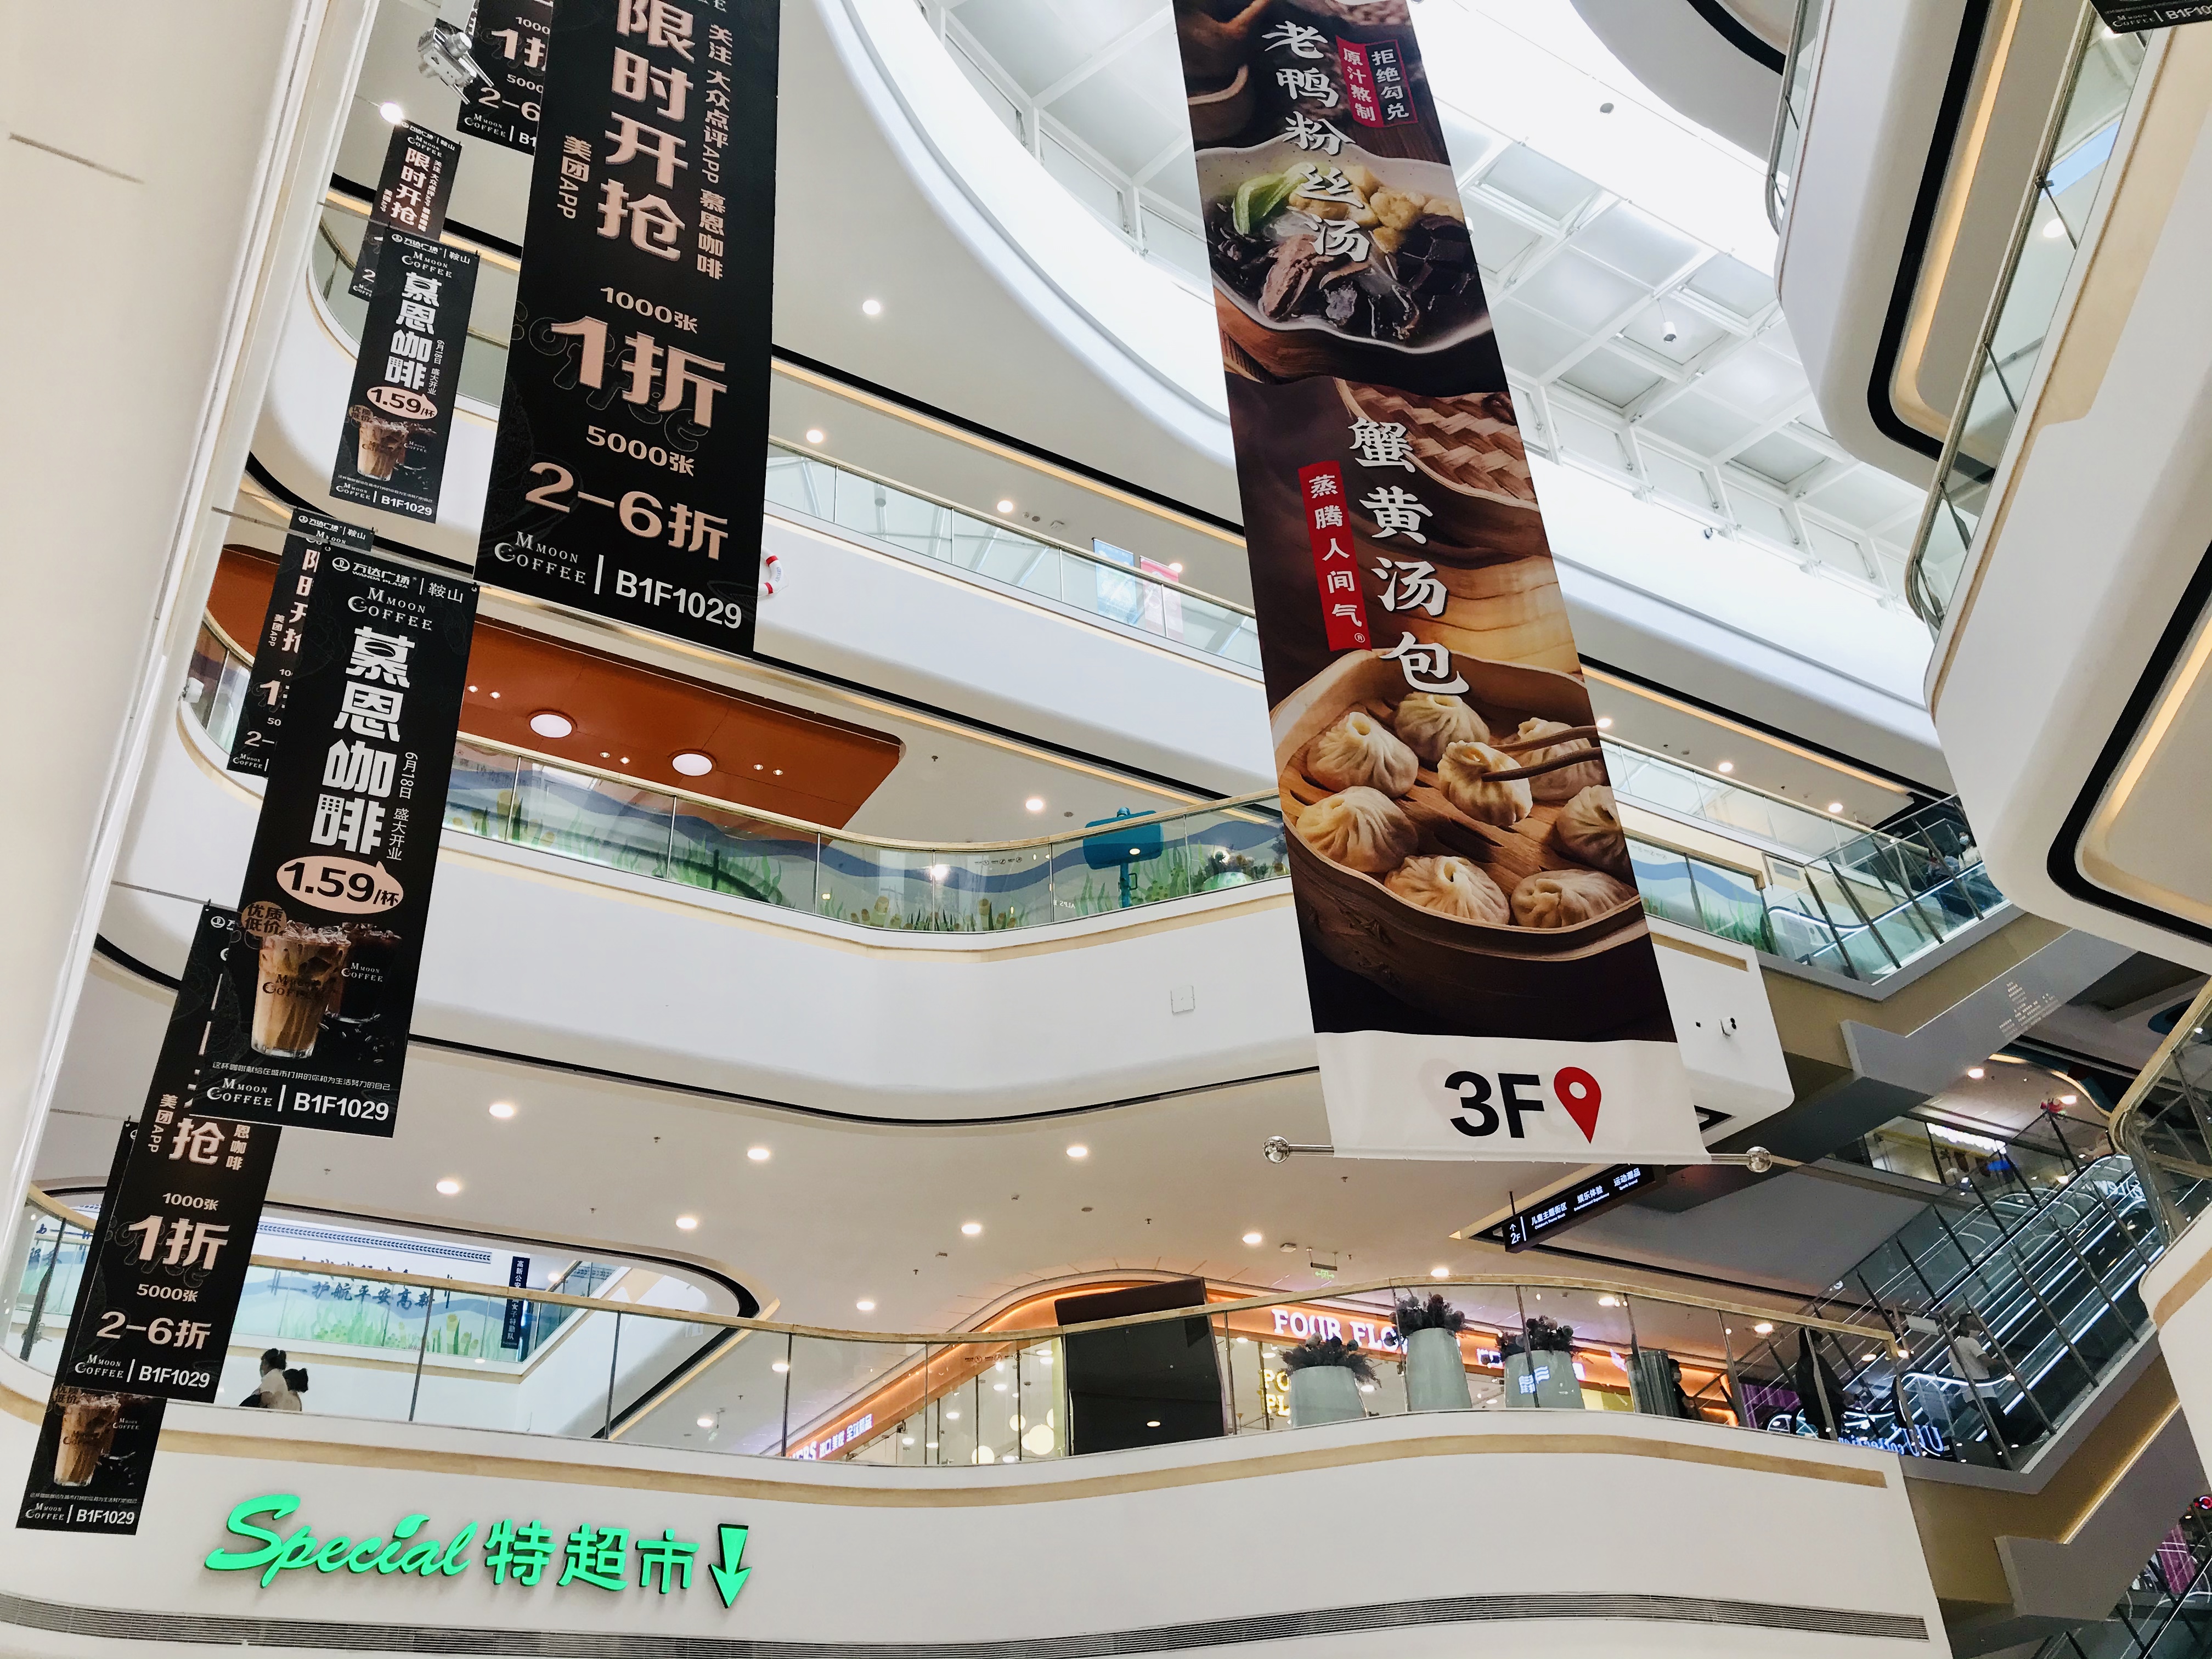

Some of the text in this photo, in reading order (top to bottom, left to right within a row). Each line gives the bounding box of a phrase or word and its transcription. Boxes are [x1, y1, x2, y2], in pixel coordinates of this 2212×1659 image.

[708, 25, 732, 66] 关注
[1343, 47, 1376, 121] 原汁熬制
[1372, 48, 1410, 121] 拒绝勾兑
[464, 117, 506, 138] COFFEE
[597, 0, 695, 262] 限时开抢
[702, 69, 731, 184] 大众点评APP
[1262, 20, 1371, 262] 老鸭粉丝汤
[390, 147, 431, 226] 限时开抢
[557, 135, 591, 219] 美团APP
[697, 188, 725, 280] 慕恩咖啡
[402, 255, 452, 278] COFFEE
[449, 251, 470, 264] 鞍山
[600, 287, 698, 334] 1000张
[385, 272, 442, 390] 慕恩咖啡
[551, 315, 727, 428] 1折
[371, 388, 435, 417] 1.59/杯
[586, 425, 695, 476] 5000张
[336, 485, 371, 500] COFFEE
[381, 495, 432, 516] B1F1029
[347, 528, 366, 540] 鞍山
[515, 531, 578, 564] MMOON
[1309, 474, 1363, 627] 蒸腾人间气
[494, 542, 586, 585] COFFEE
[1348, 416, 1469, 695] 蟹黄汤包
[353, 562, 463, 603] 万达广场 鞍山
[367, 587, 425, 613] MMOON
[616, 569, 742, 629] B1F1029
[268, 614, 284, 647] 美团APP
[348, 596, 433, 631] COFFEE
[310, 626, 415, 855] 慕恩咖啡
[233, 757, 262, 769] COFFEE
[386, 752, 418, 861] 6月18日 盛大开业
[284, 862, 399, 906] 1.59/杯
[247, 905, 283, 922] 优质
[341, 968, 383, 982] COFFEE
[207, 1086, 273, 1107] COFFEE
[222, 1078, 268, 1093] MMOON
[1444, 1070, 1546, 1138] 3F
[148, 1094, 178, 1153] 美团APP
[294, 1092, 389, 1120] B1F1029
[226, 1124, 251, 1171] 恩咖啡
[1577, 1185, 1603, 1204] 娱乐体验
[1613, 1167, 1641, 1187] 运动潮品
[162, 1193, 219, 1211] 1000张
[128, 1215, 231, 1270] 1折
[1510, 1233, 1521, 1245] 2F
[137, 1284, 199, 1302] 5000张
[75, 1362, 124, 1378] COFFEE
[139, 1366, 210, 1388] B1F1029
[25, 1509, 64, 1521] COFFEE
[76, 1510, 135, 1525] B1F1029
[205, 1493, 699, 1594] Special 特超市
